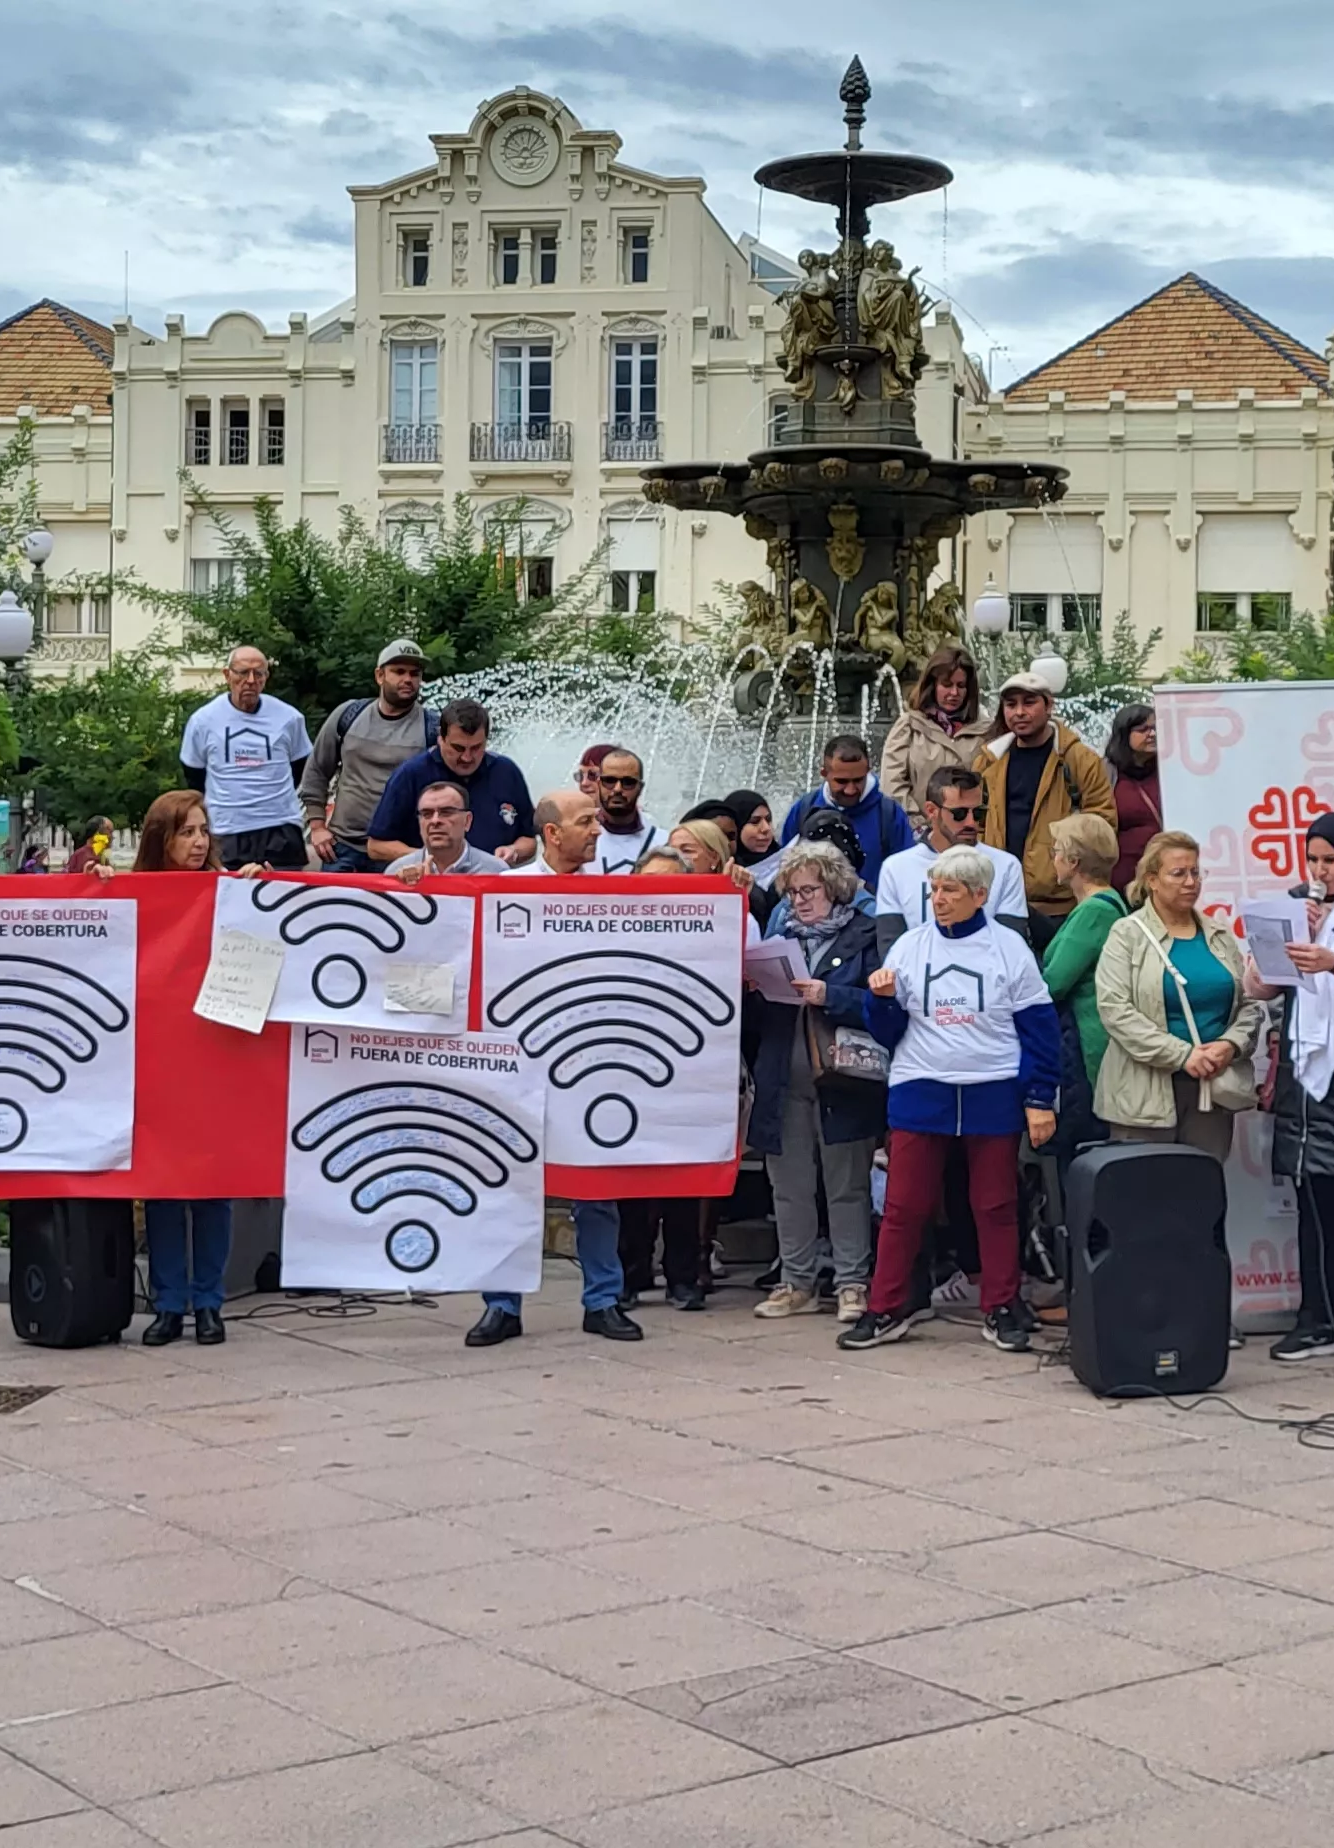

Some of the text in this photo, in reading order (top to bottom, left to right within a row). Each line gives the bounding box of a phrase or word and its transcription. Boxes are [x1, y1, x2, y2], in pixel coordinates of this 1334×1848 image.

[0, 909, 31, 921] QUE
[33, 909, 49, 921] SE
[52, 909, 108, 921] QUEDEN
[543, 904, 715, 916] NO DEJES QUE SE QUEDEN
[11, 924, 108, 938] COBERTURA
[543, 919, 715, 933] FUERA DE COBERTURA
[350, 1033, 520, 1056] NO DEJES QUE SE QUEDEN
[350, 1047, 401, 1063] FUERA
[404, 1051, 424, 1065] DE
[427, 1053, 519, 1073] COBERTURA
